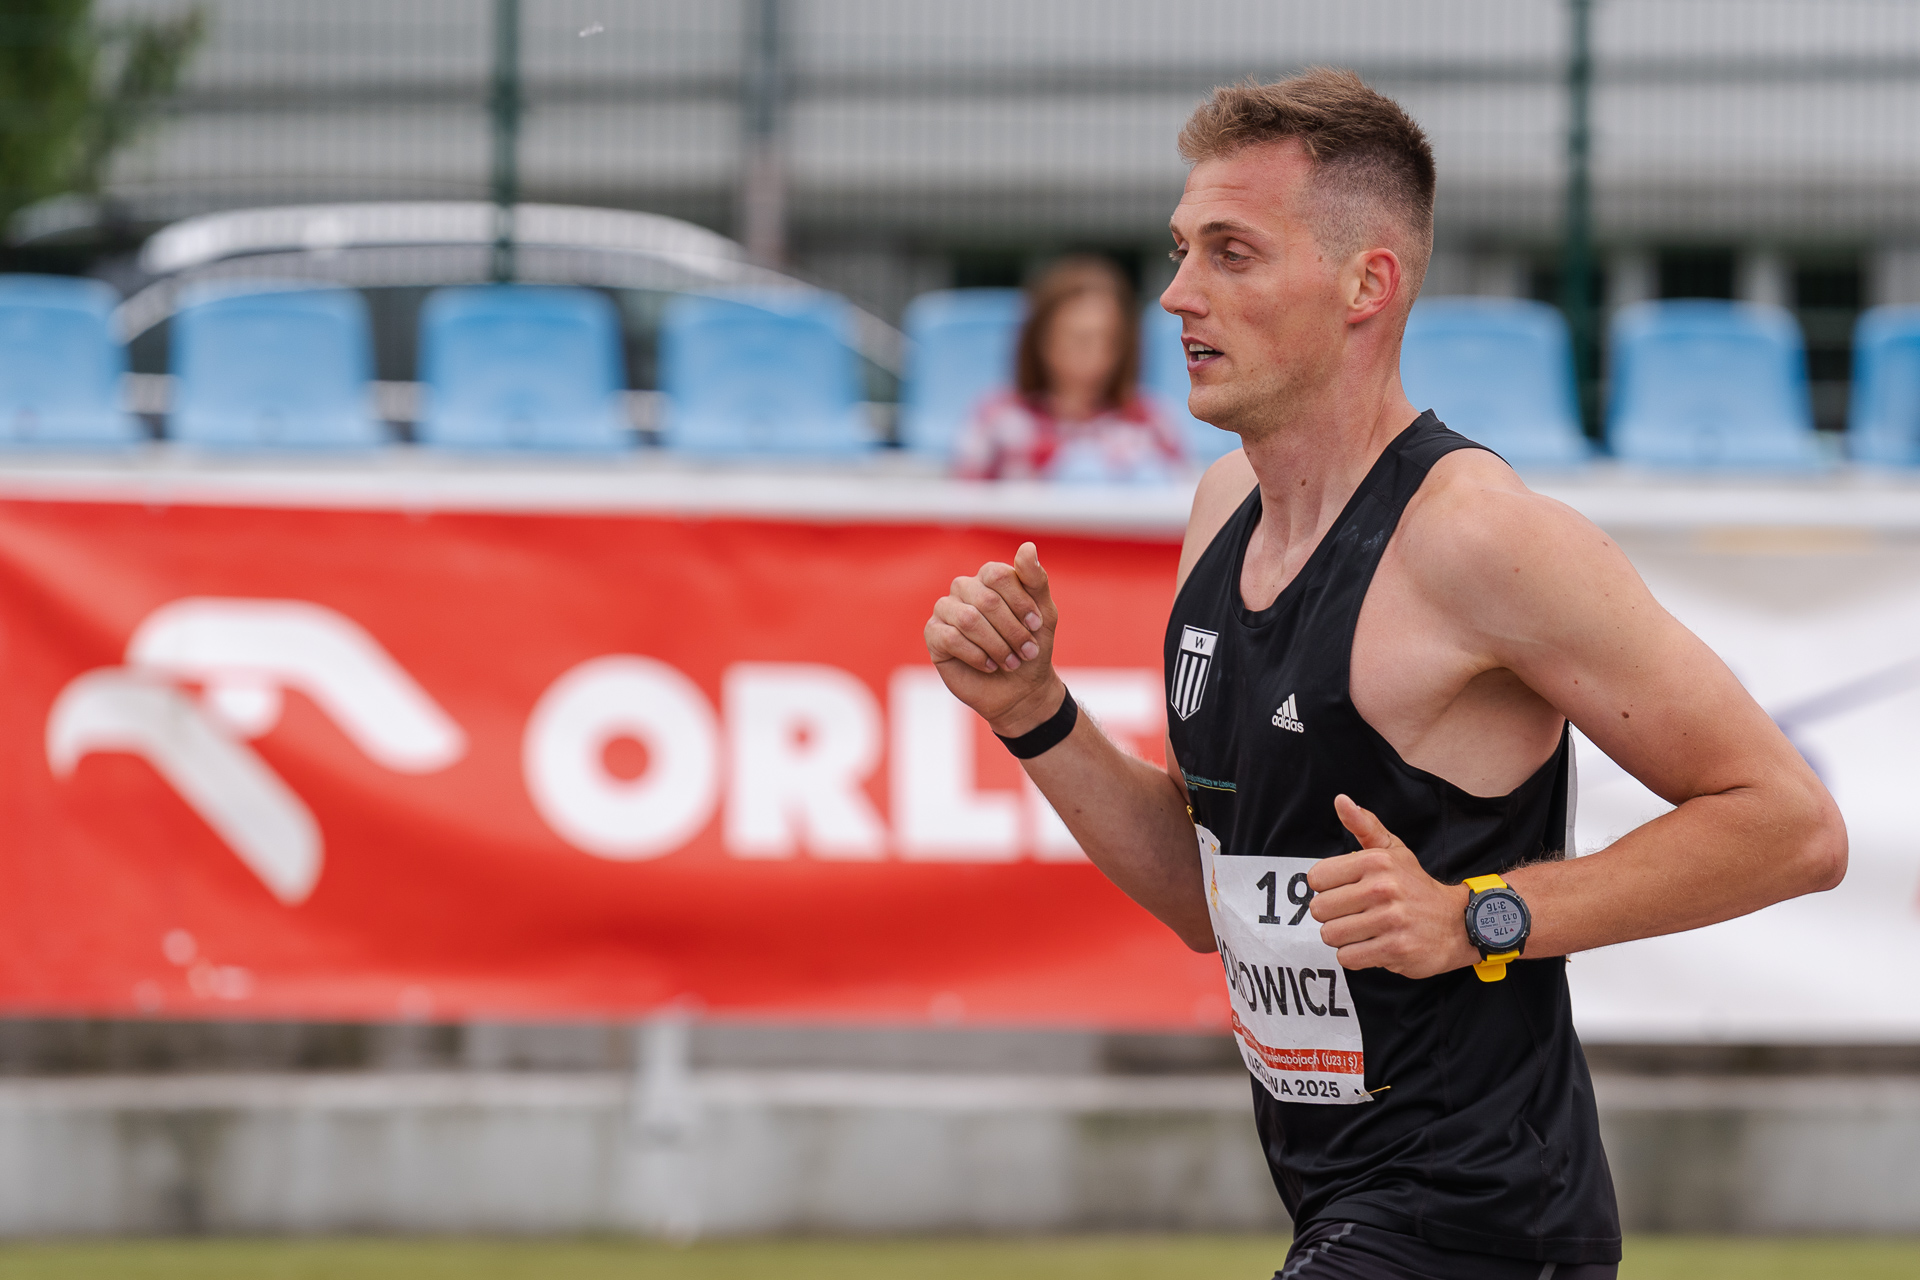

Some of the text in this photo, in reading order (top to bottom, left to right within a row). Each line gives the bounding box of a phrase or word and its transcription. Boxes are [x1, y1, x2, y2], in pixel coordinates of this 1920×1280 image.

[1194, 636, 1207, 650] W
[1271, 714, 1304, 733] adidas
[1486, 901, 1506, 912] 3:16
[1480, 916, 1495, 925] 0:25
[1502, 912, 1517, 921] 0.13
[1493, 927, 1508, 936] 175
[1321, 1053, 1341, 1067] (U23
[1342, 1056, 1347, 1066] i
[1294, 1079, 1341, 1098] 2025
